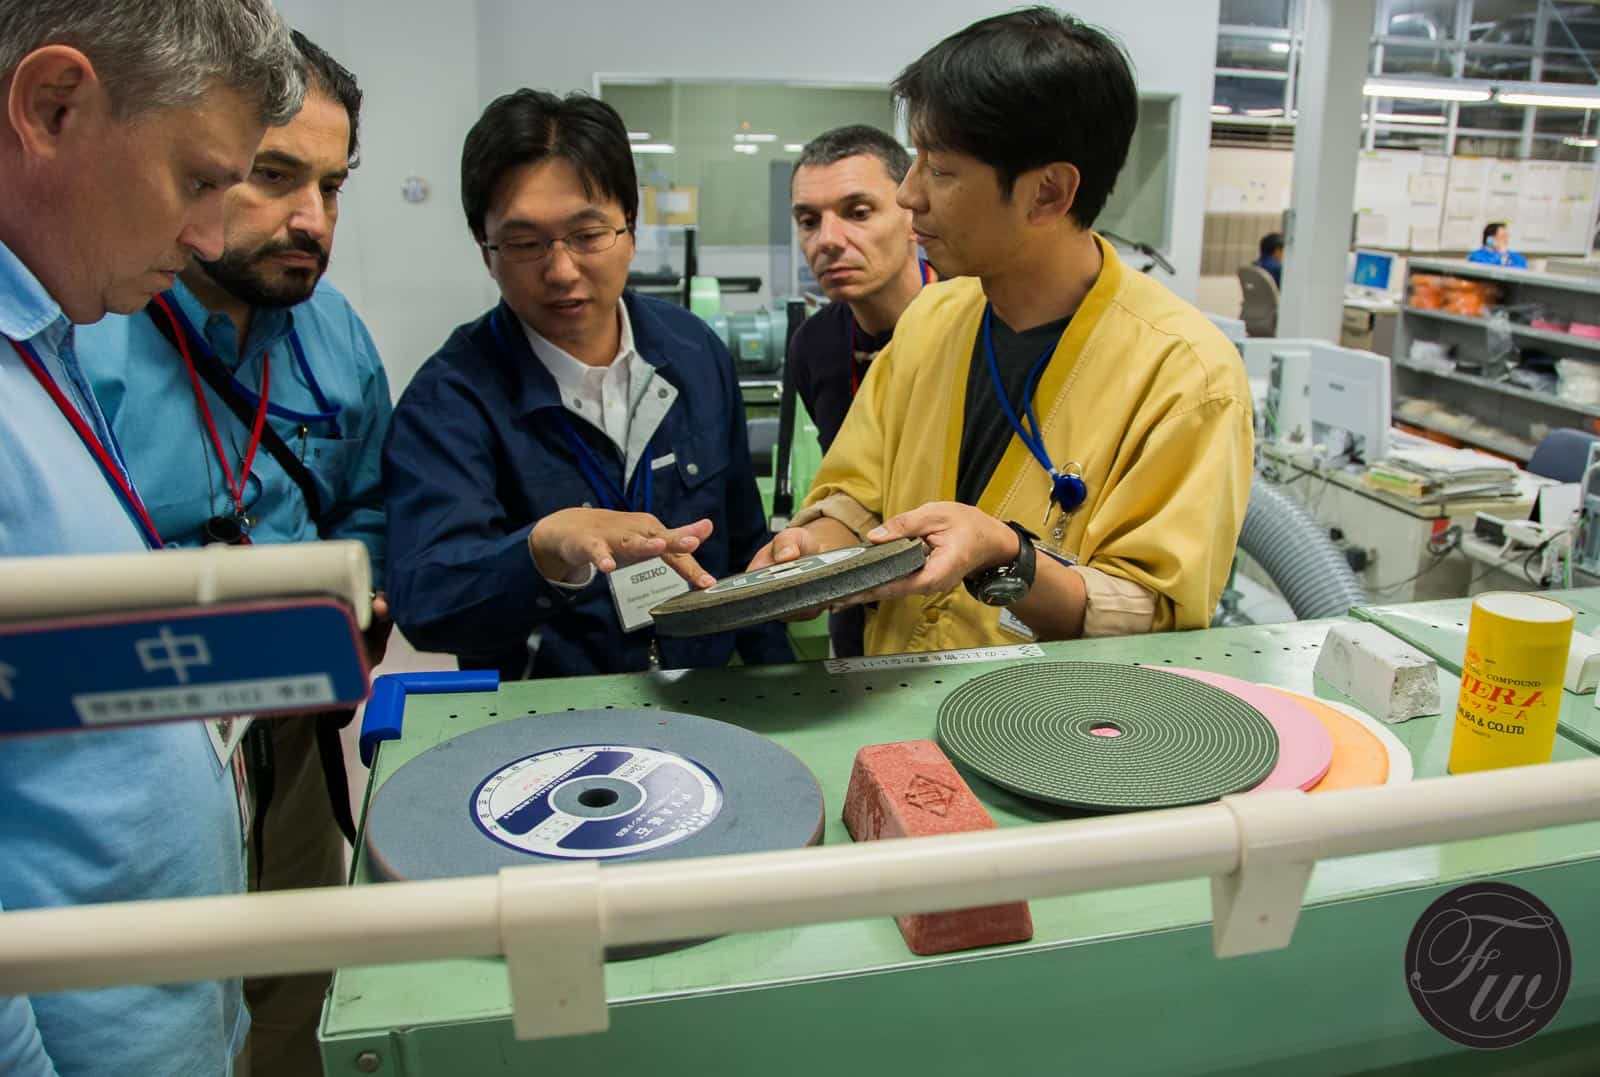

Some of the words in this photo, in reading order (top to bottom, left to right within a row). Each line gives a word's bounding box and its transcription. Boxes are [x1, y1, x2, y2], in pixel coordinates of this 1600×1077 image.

[630, 566, 668, 585] SEIKO
[135, 625, 211, 684] 中
[1486, 673, 1542, 688] COMPOUND
[1477, 717, 1486, 728] &
